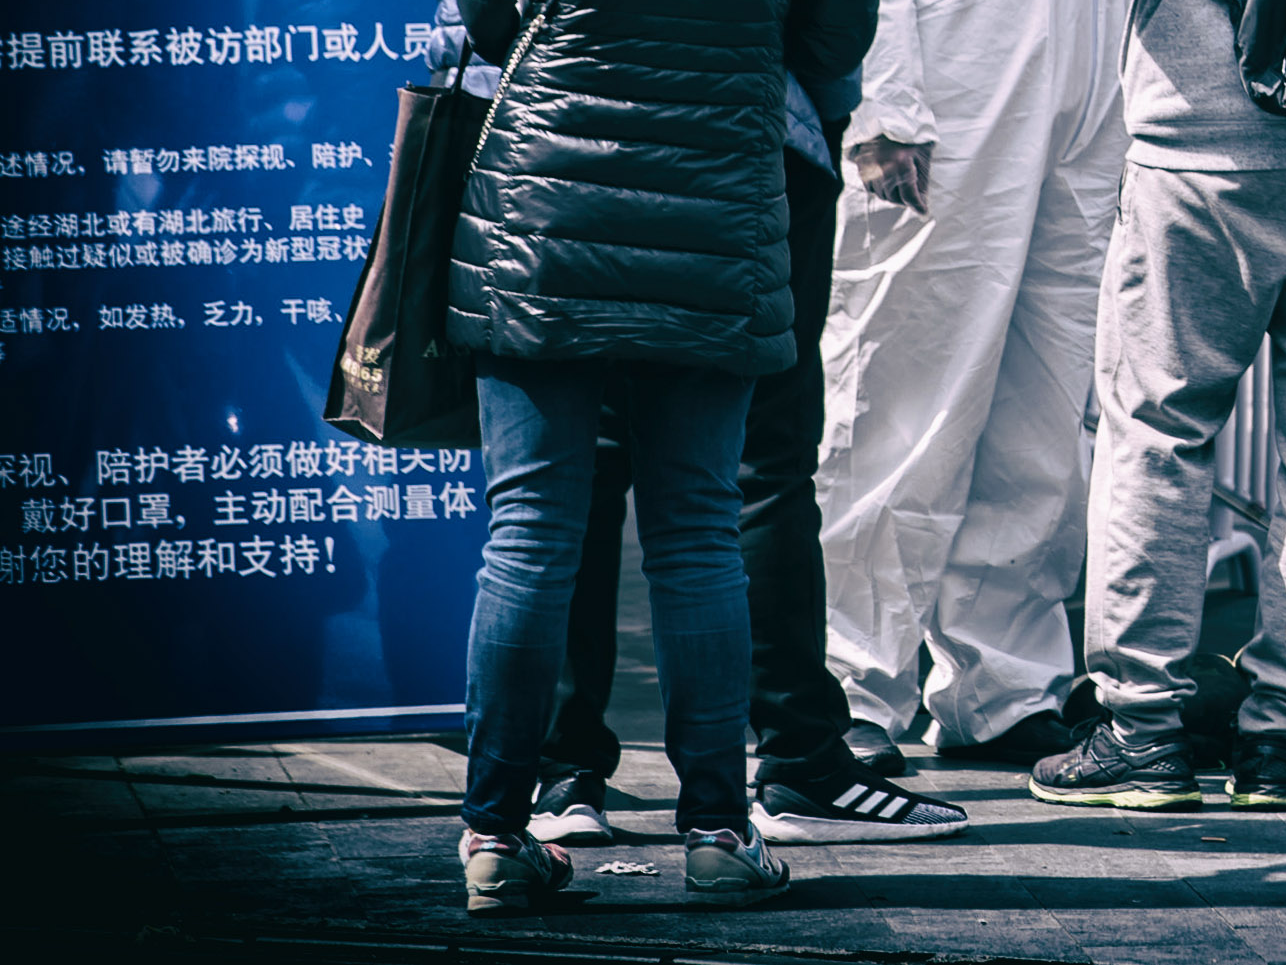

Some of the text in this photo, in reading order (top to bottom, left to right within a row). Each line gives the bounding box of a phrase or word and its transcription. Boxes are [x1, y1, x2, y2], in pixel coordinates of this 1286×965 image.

[0, 22, 434, 70] 提前联系被访部门或人员
[1, 203, 366, 239] 途经湖北或有湖北旅行、居住史
[3, 235, 372, 271] 接触过疑似或被确诊为新型冠状
[21, 481, 477, 533] 戴好口罩，主动配合测量体
